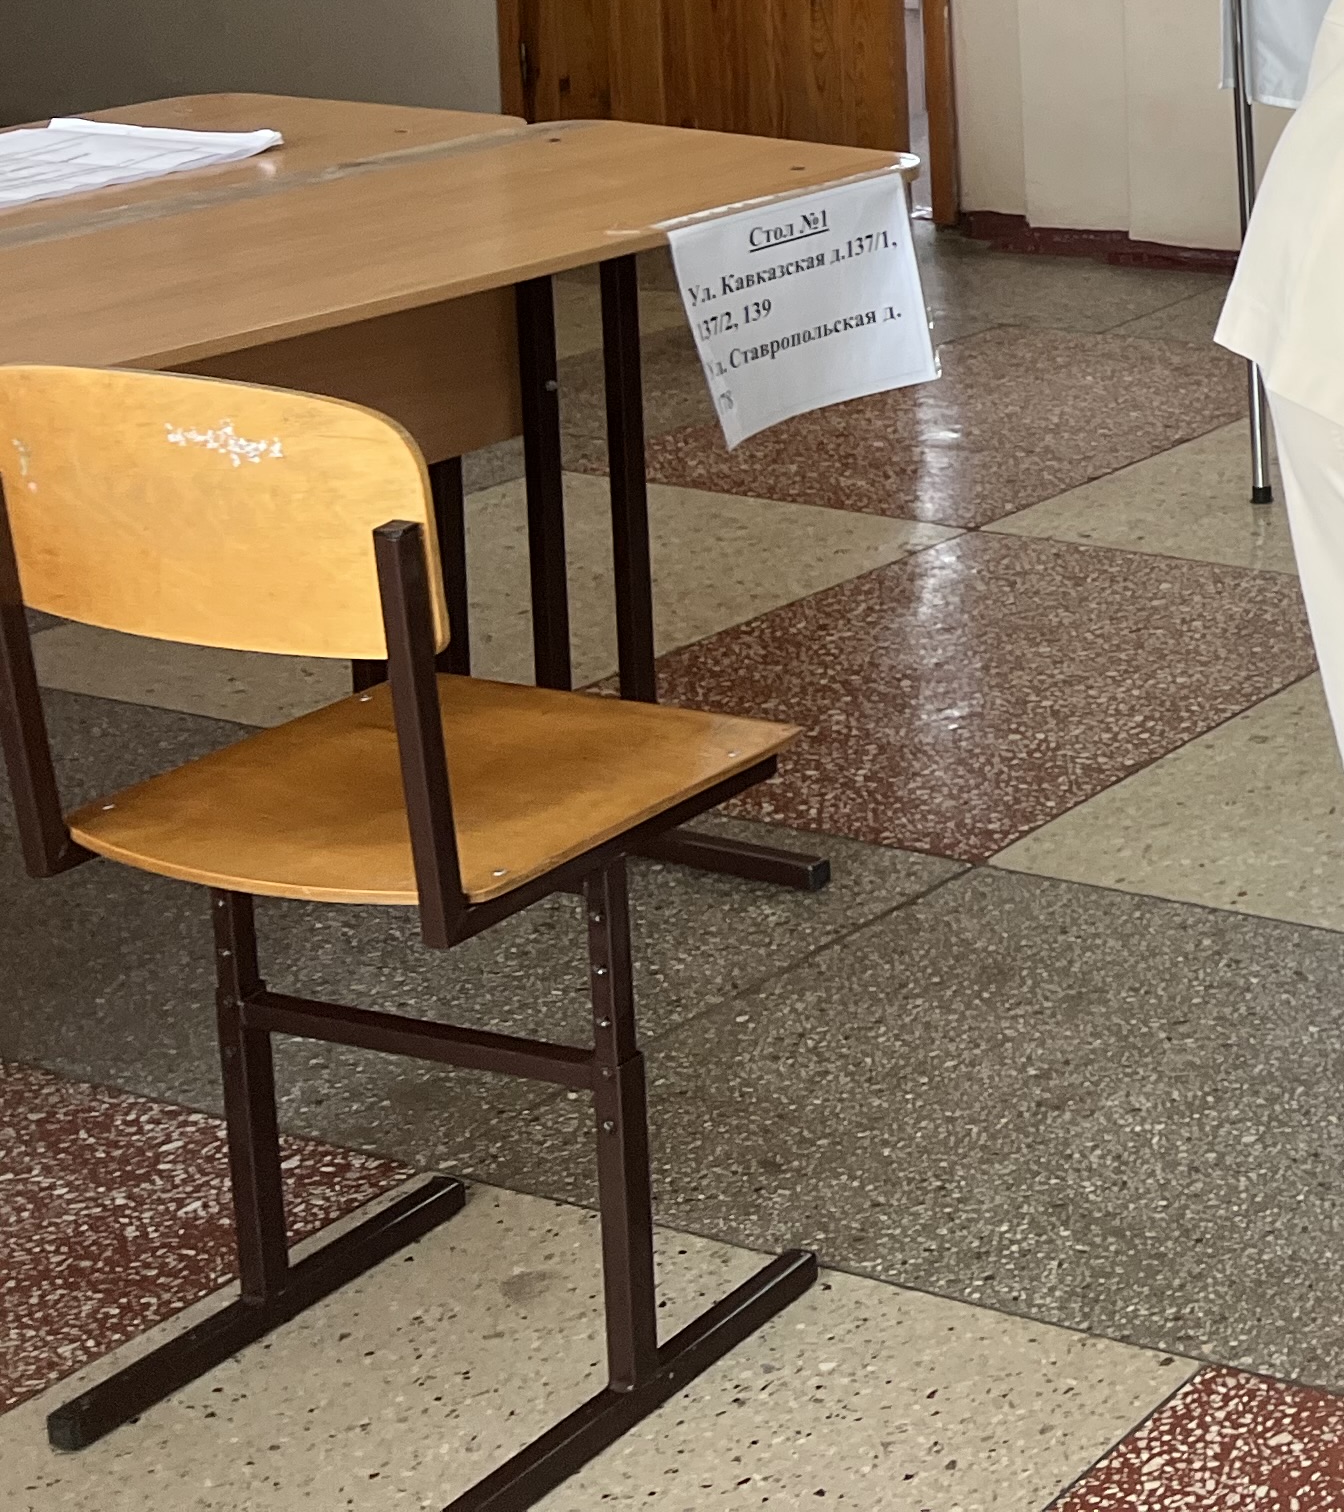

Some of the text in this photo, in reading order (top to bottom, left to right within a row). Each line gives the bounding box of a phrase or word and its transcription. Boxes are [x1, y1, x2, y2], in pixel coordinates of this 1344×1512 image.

[749, 209, 828, 247] Стол №1
[688, 285, 717, 307] Ул.
[721, 253, 826, 296] Кавказская
[744, 299, 772, 324] 139
[729, 310, 877, 368] Ставропольская
[883, 305, 902, 323] д.
